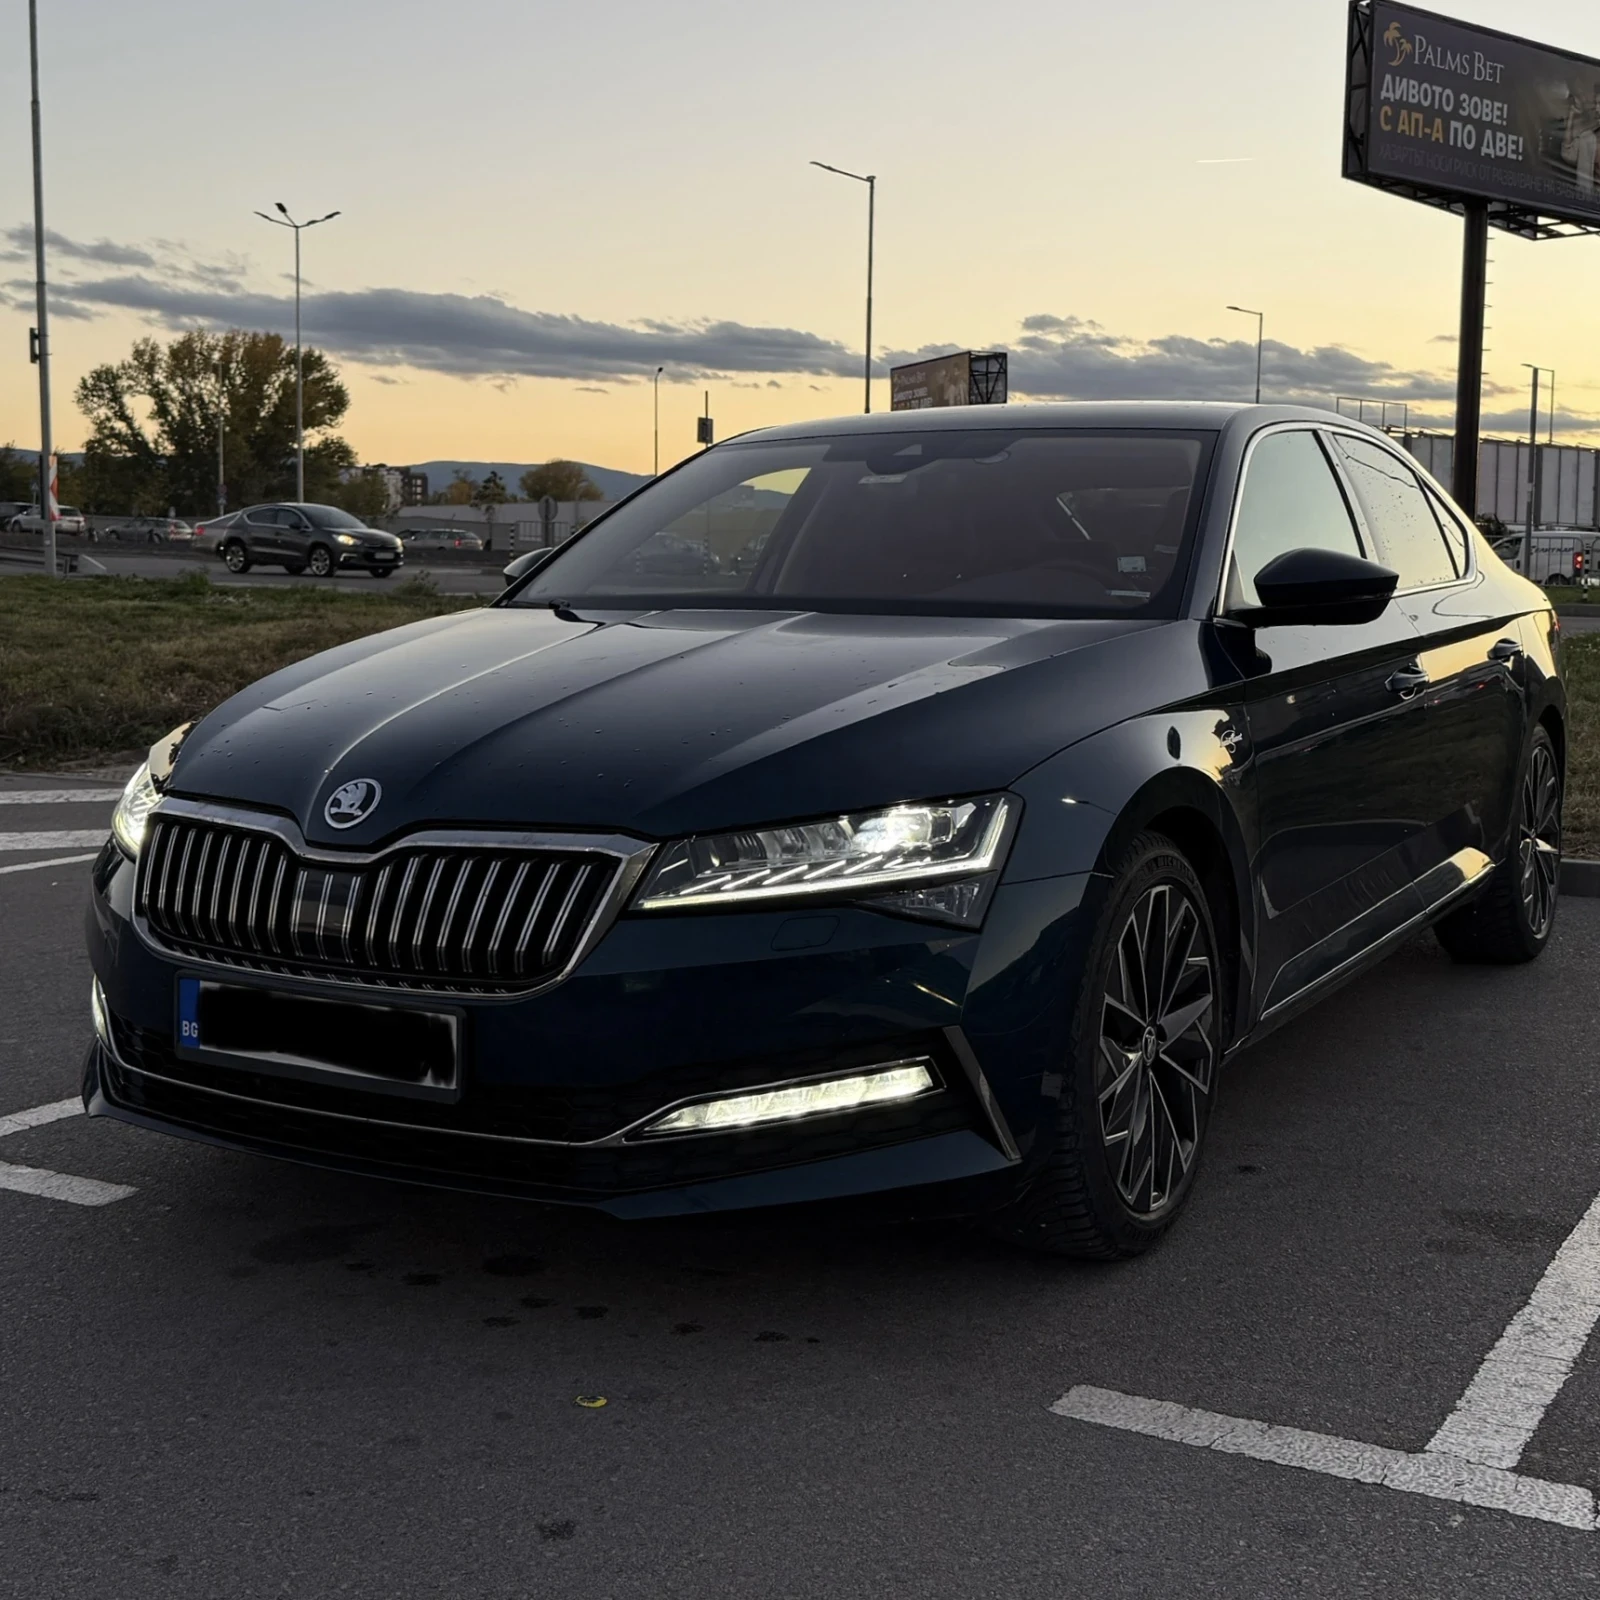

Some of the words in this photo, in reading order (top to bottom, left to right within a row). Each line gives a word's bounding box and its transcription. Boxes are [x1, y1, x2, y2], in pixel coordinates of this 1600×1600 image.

[1380, 74, 1454, 112] ДИВОТО
[1459, 93, 1508, 126] ЗОВЕ!
[1380, 105, 1392, 131] С
[1397, 109, 1444, 143] АП-А
[1450, 121, 1476, 150] ПО
[1481, 130, 1523, 161] ДВЕ!
[182, 1021, 198, 1037] BG
